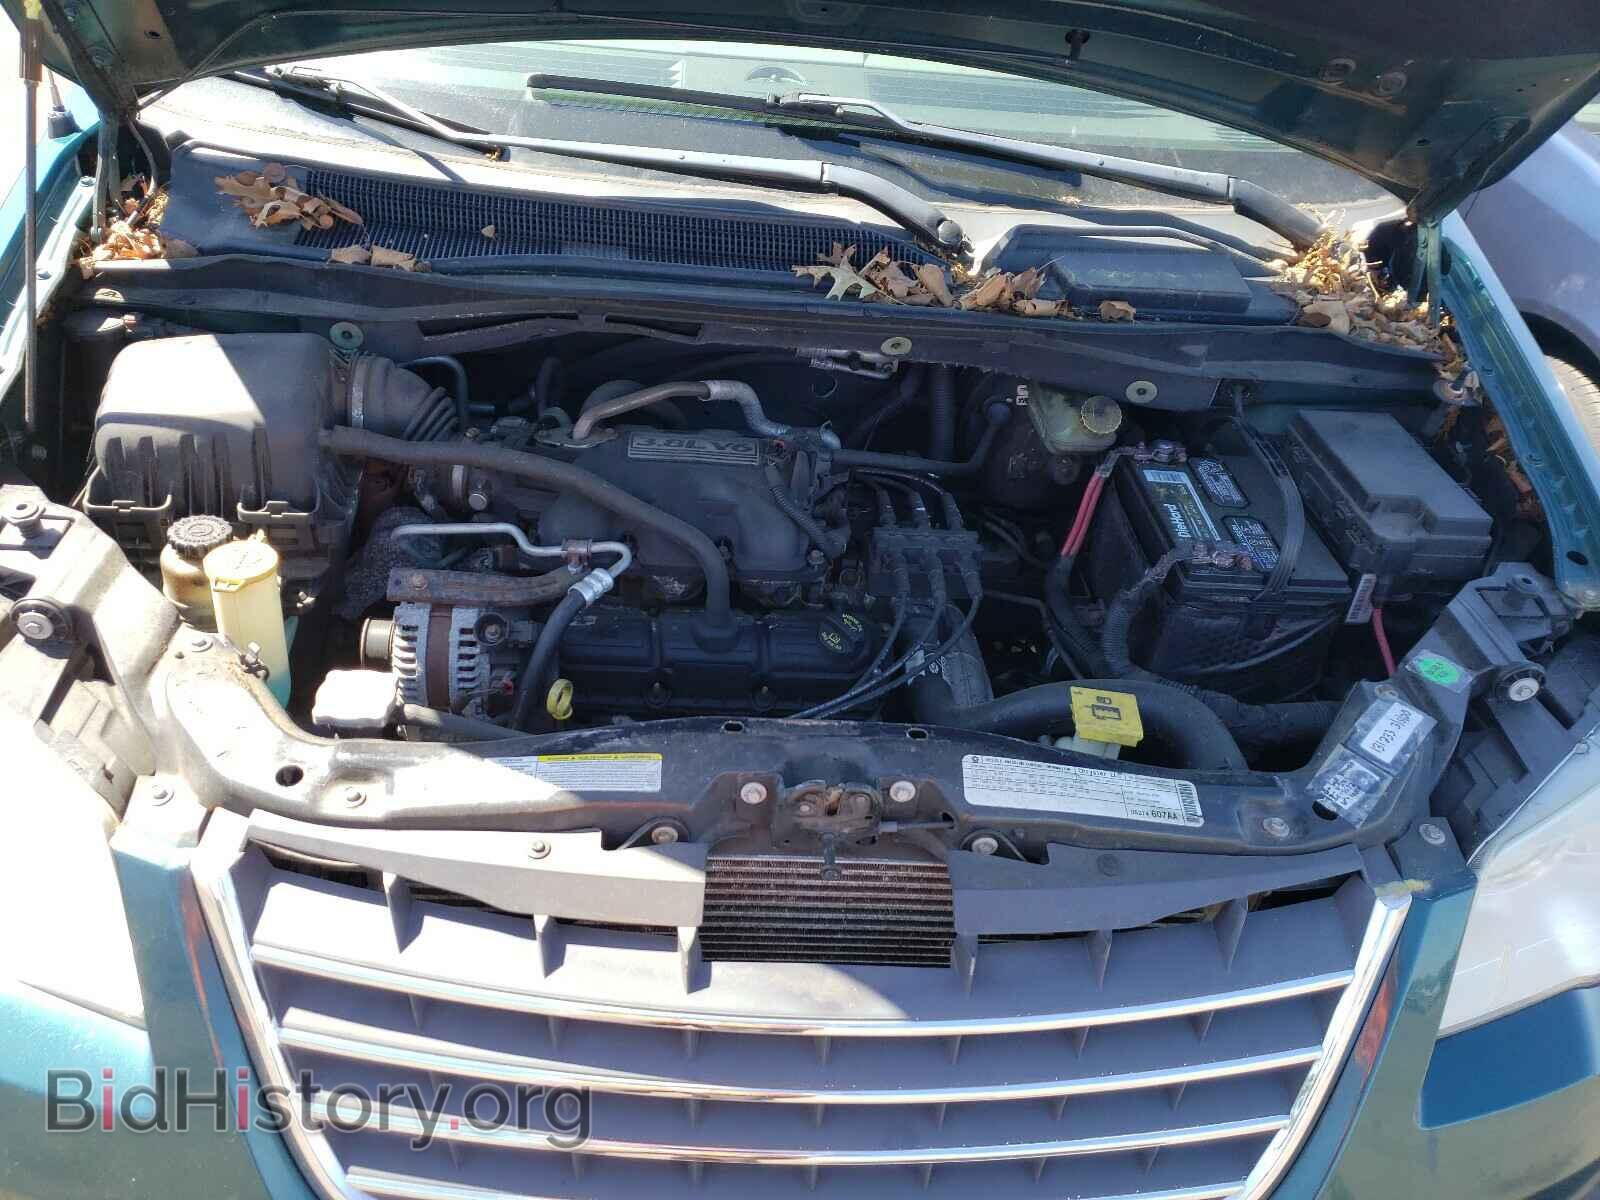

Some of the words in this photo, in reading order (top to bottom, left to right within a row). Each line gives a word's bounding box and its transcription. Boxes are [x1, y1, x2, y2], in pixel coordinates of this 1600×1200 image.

[637, 438, 706, 450] 3.8L
[711, 440, 754, 453] V6
[1163, 503, 1192, 538] DieHard
[1151, 810, 1178, 820] 607AA
